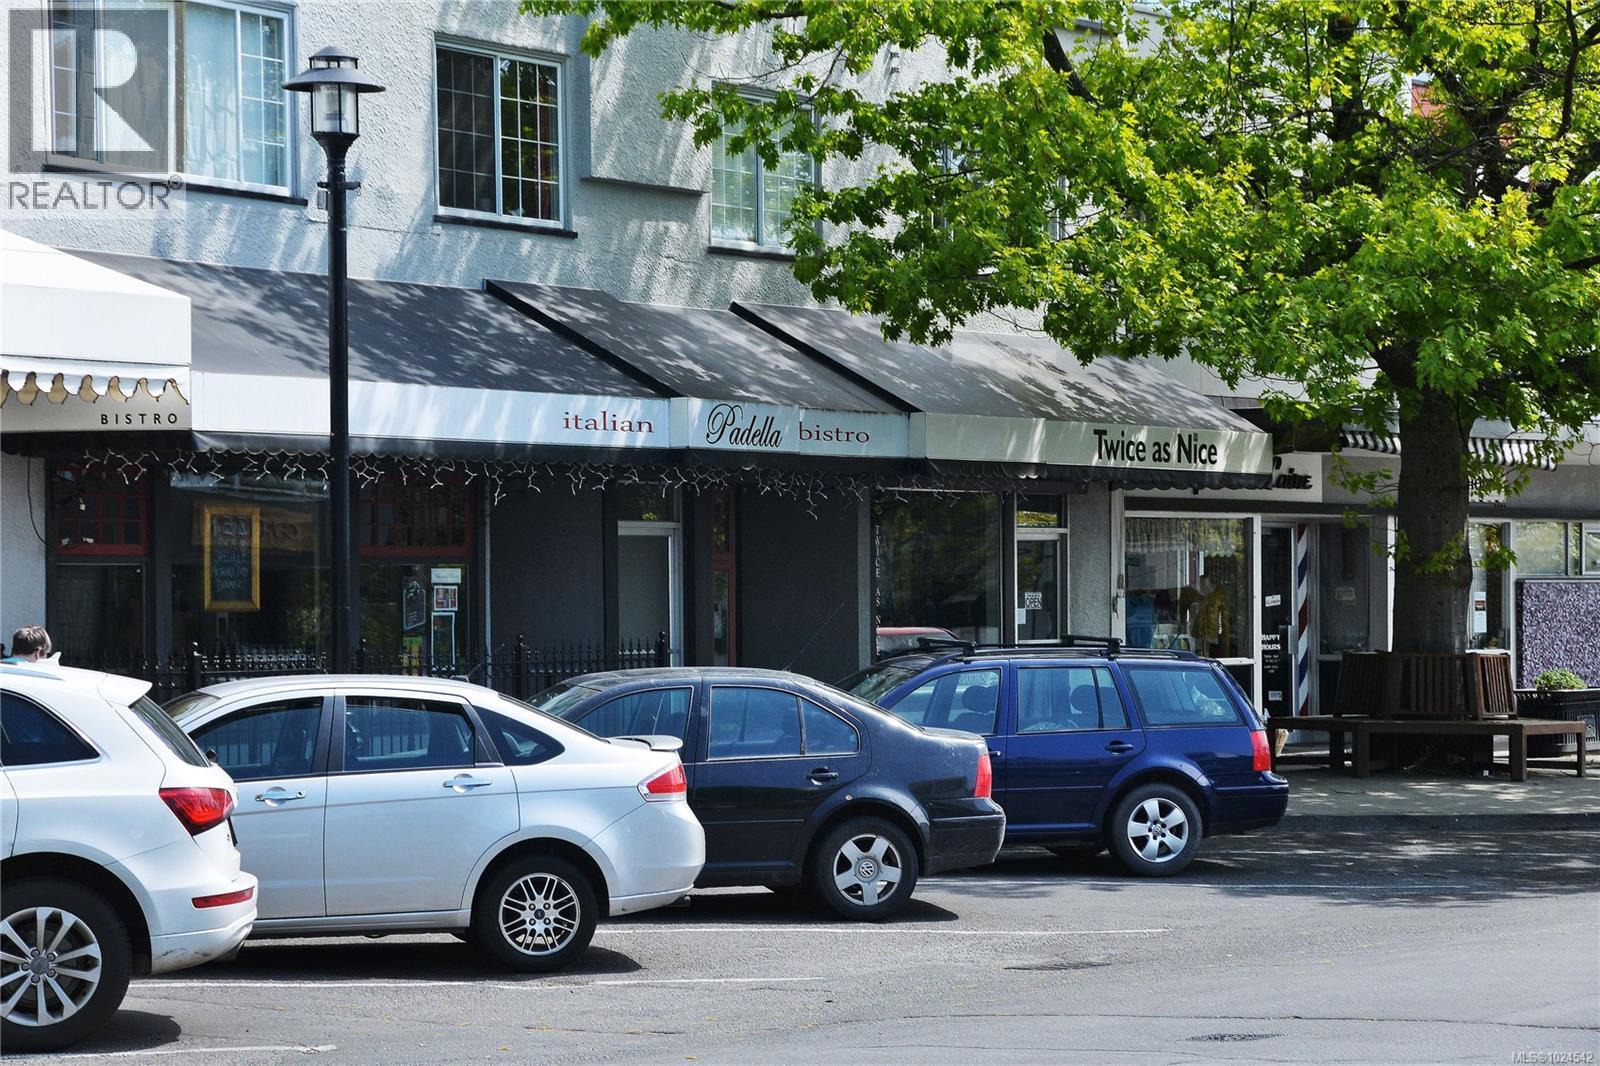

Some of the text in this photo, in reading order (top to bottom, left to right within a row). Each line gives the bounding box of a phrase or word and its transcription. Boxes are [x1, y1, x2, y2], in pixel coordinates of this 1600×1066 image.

[100, 412, 178, 425] BISTRO
[562, 411, 654, 433] italian
[705, 403, 783, 448] Padella
[799, 421, 870, 443] bistro
[1093, 429, 1218, 465] Twice as Nice
[1026, 597, 1041, 608] OPEN
